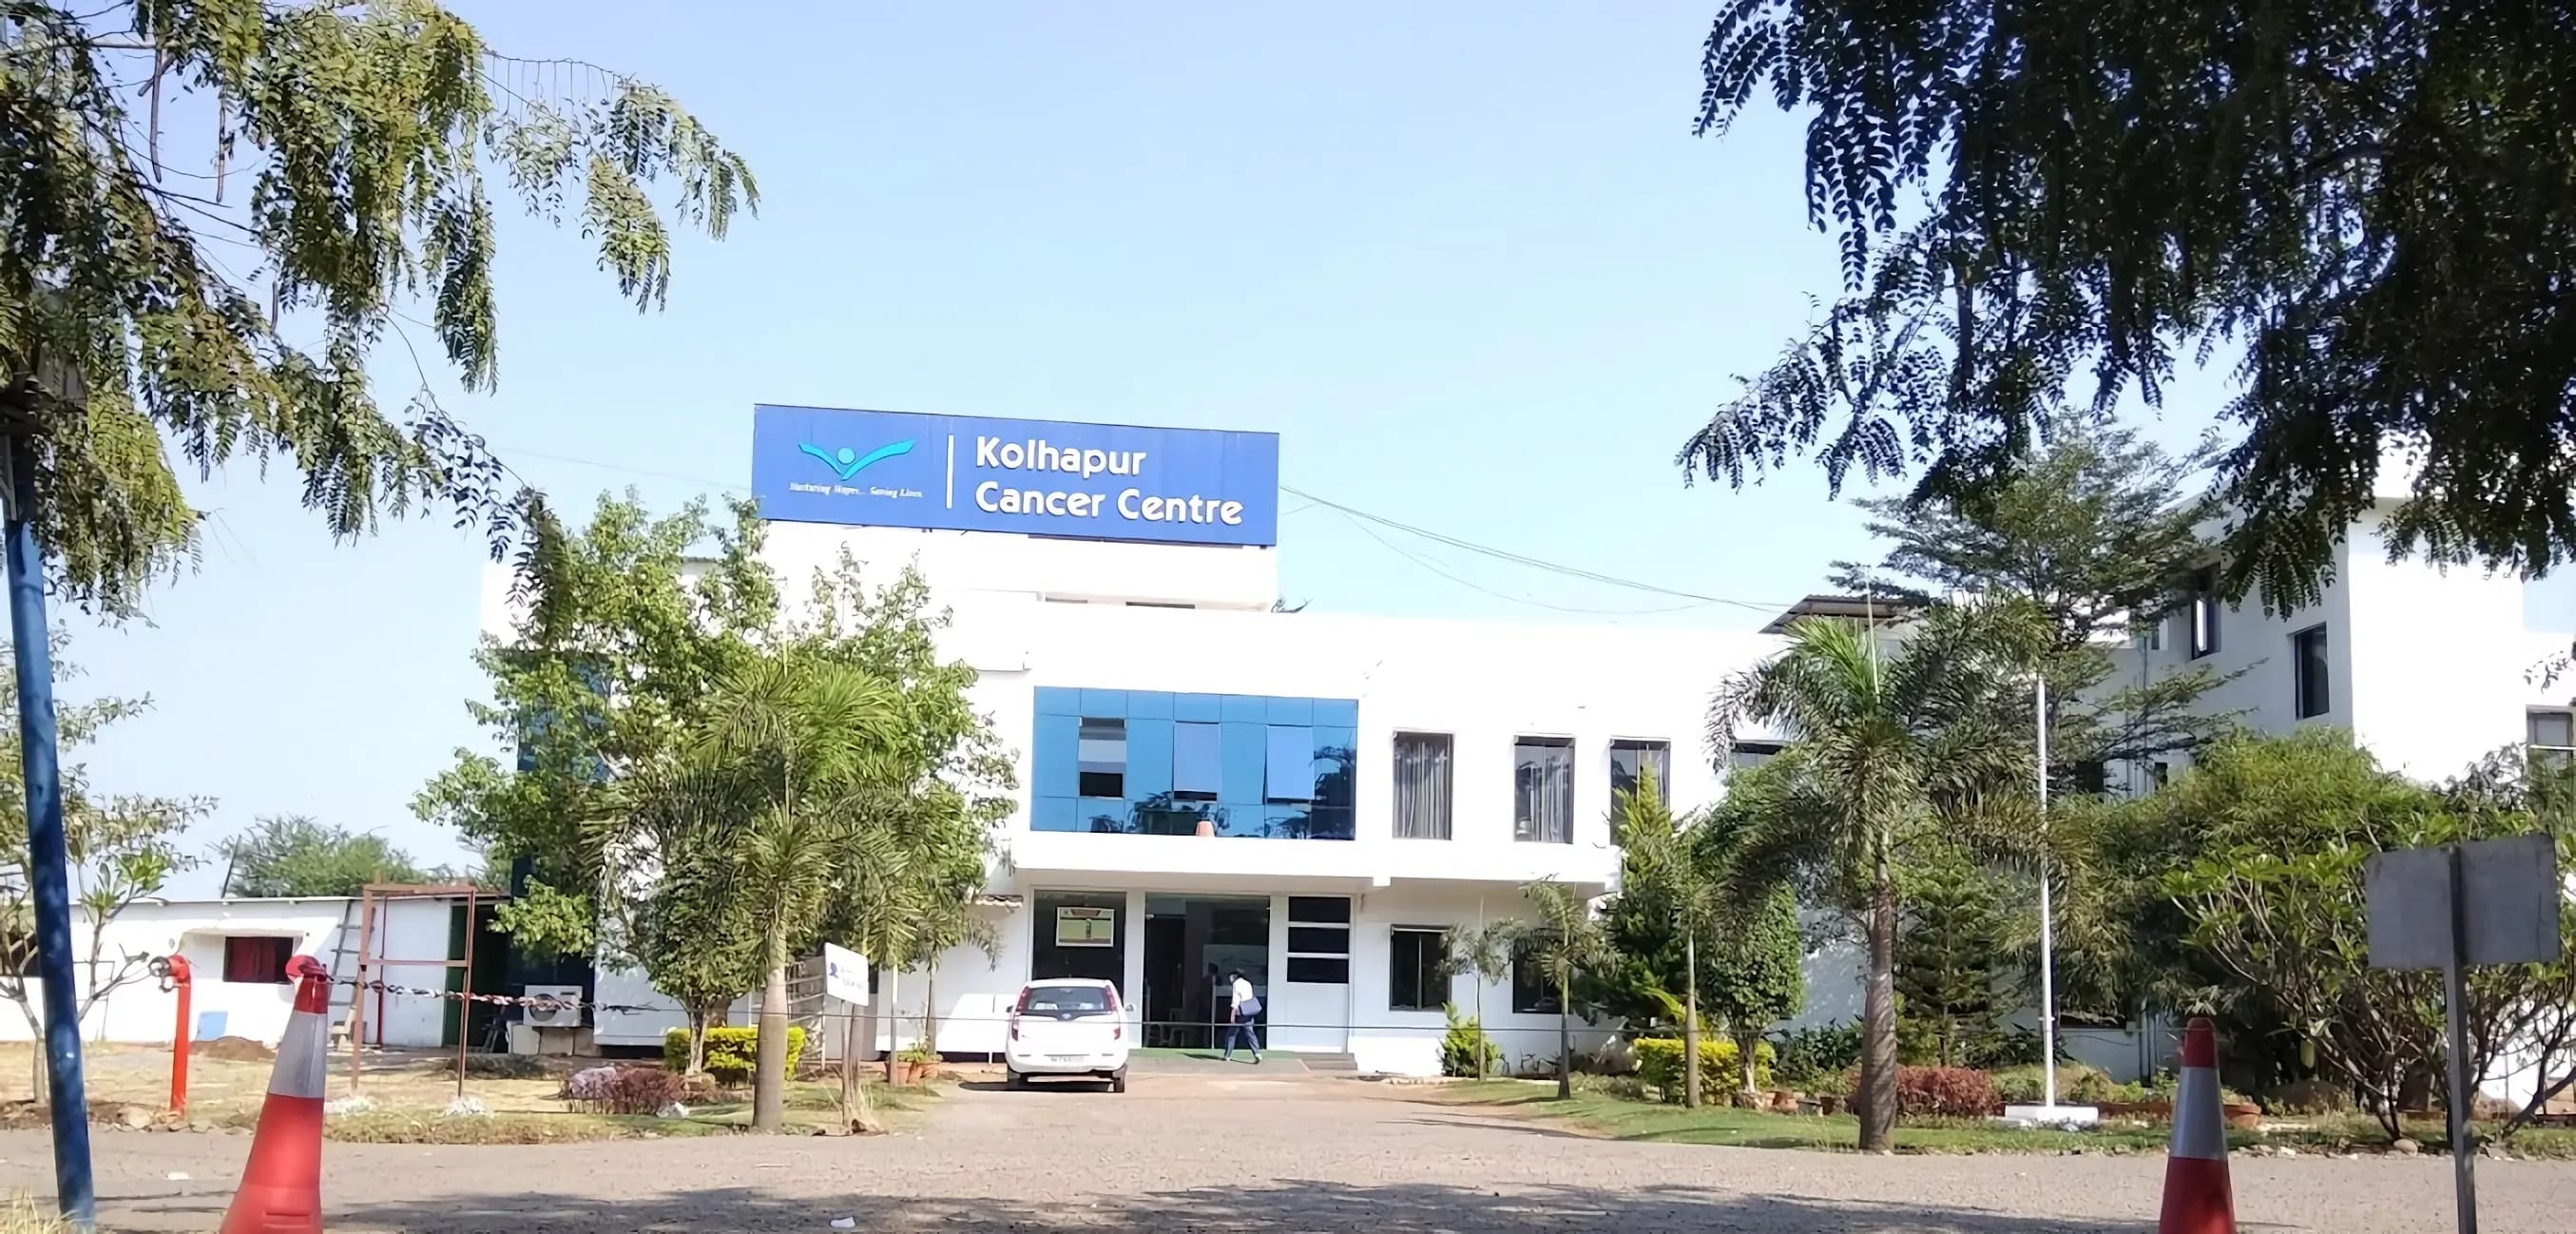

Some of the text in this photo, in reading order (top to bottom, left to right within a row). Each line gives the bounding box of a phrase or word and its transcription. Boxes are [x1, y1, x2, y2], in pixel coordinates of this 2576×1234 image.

[975, 435, 1146, 479] Kolhapur
[974, 480, 1243, 525] Cancer Centre
